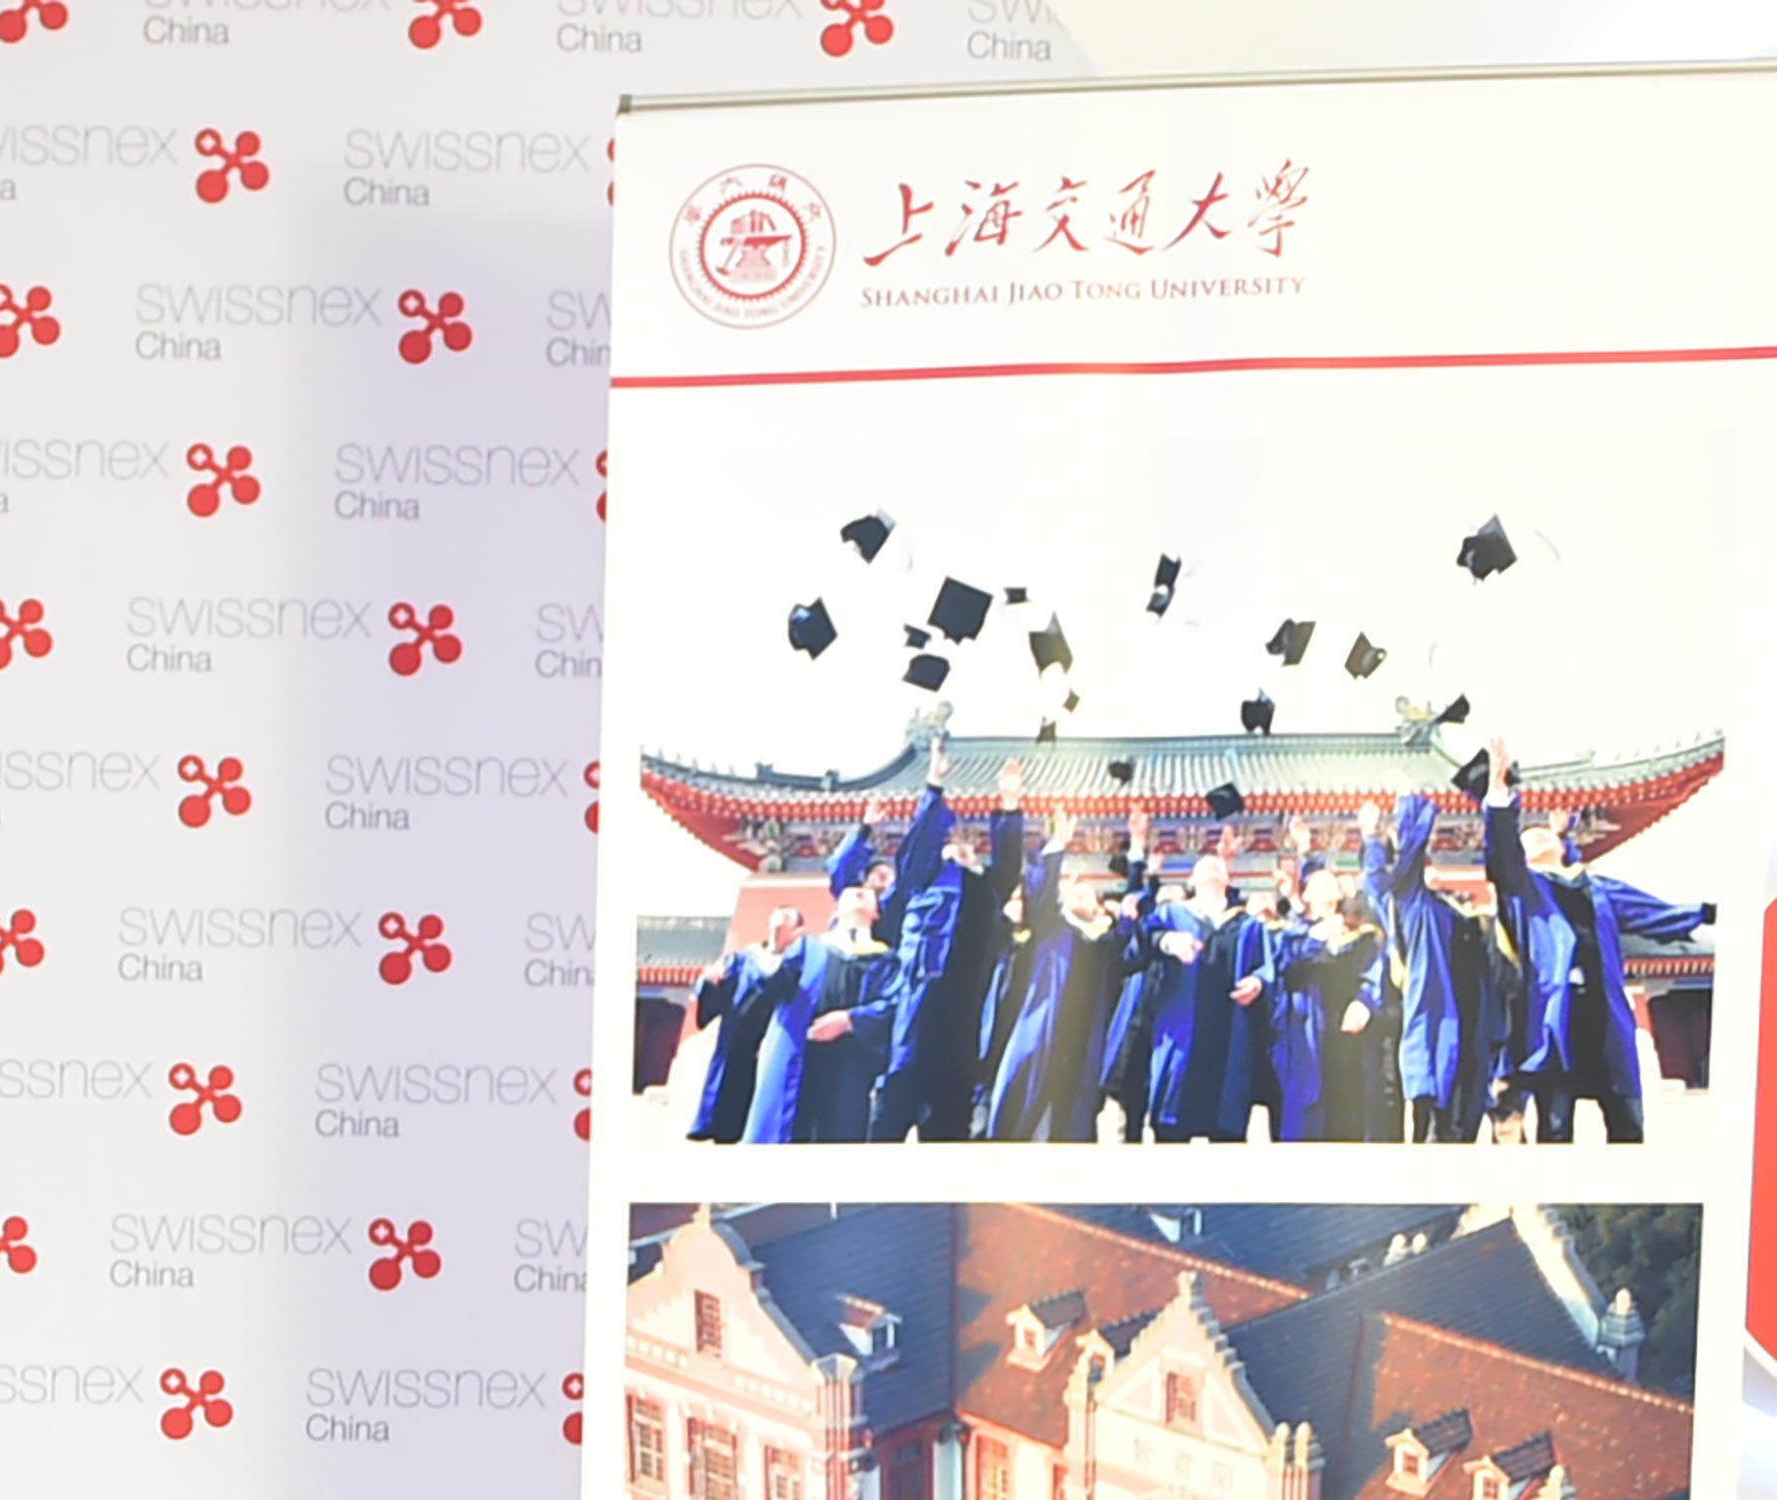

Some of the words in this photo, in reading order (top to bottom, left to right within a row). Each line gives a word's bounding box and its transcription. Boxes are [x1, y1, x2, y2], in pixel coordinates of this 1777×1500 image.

[143, 14, 229, 45] China
[556, 22, 642, 53] China
[964, 27, 1050, 57] China
[345, 129, 590, 172] swissnex
[343, 176, 430, 207] China
[135, 284, 380, 326] swissnex
[861, 284, 999, 308] SHANGHAI
[1008, 281, 1063, 305] JIAO
[1070, 279, 1142, 301] TONG
[1149, 276, 1307, 300] UNIVERSITY
[135, 330, 221, 361] China
[545, 337, 612, 367] Chin
[337, 443, 580, 485] swissnex
[334, 490, 420, 520] China
[127, 597, 371, 639] swissnex
[126, 643, 212, 672] China
[535, 649, 602, 679] Chin
[327, 754, 570, 796] swissnex
[325, 800, 410, 831] China
[118, 906, 361, 948] swissnex
[118, 953, 203, 982] China
[318, 1062, 559, 1104] swissnex
[315, 1109, 400, 1139] China
[110, 1213, 351, 1254] swissnex
[109, 1259, 194, 1288] China
[308, 1367, 548, 1408] swissnex
[305, 1413, 390, 1443] China
